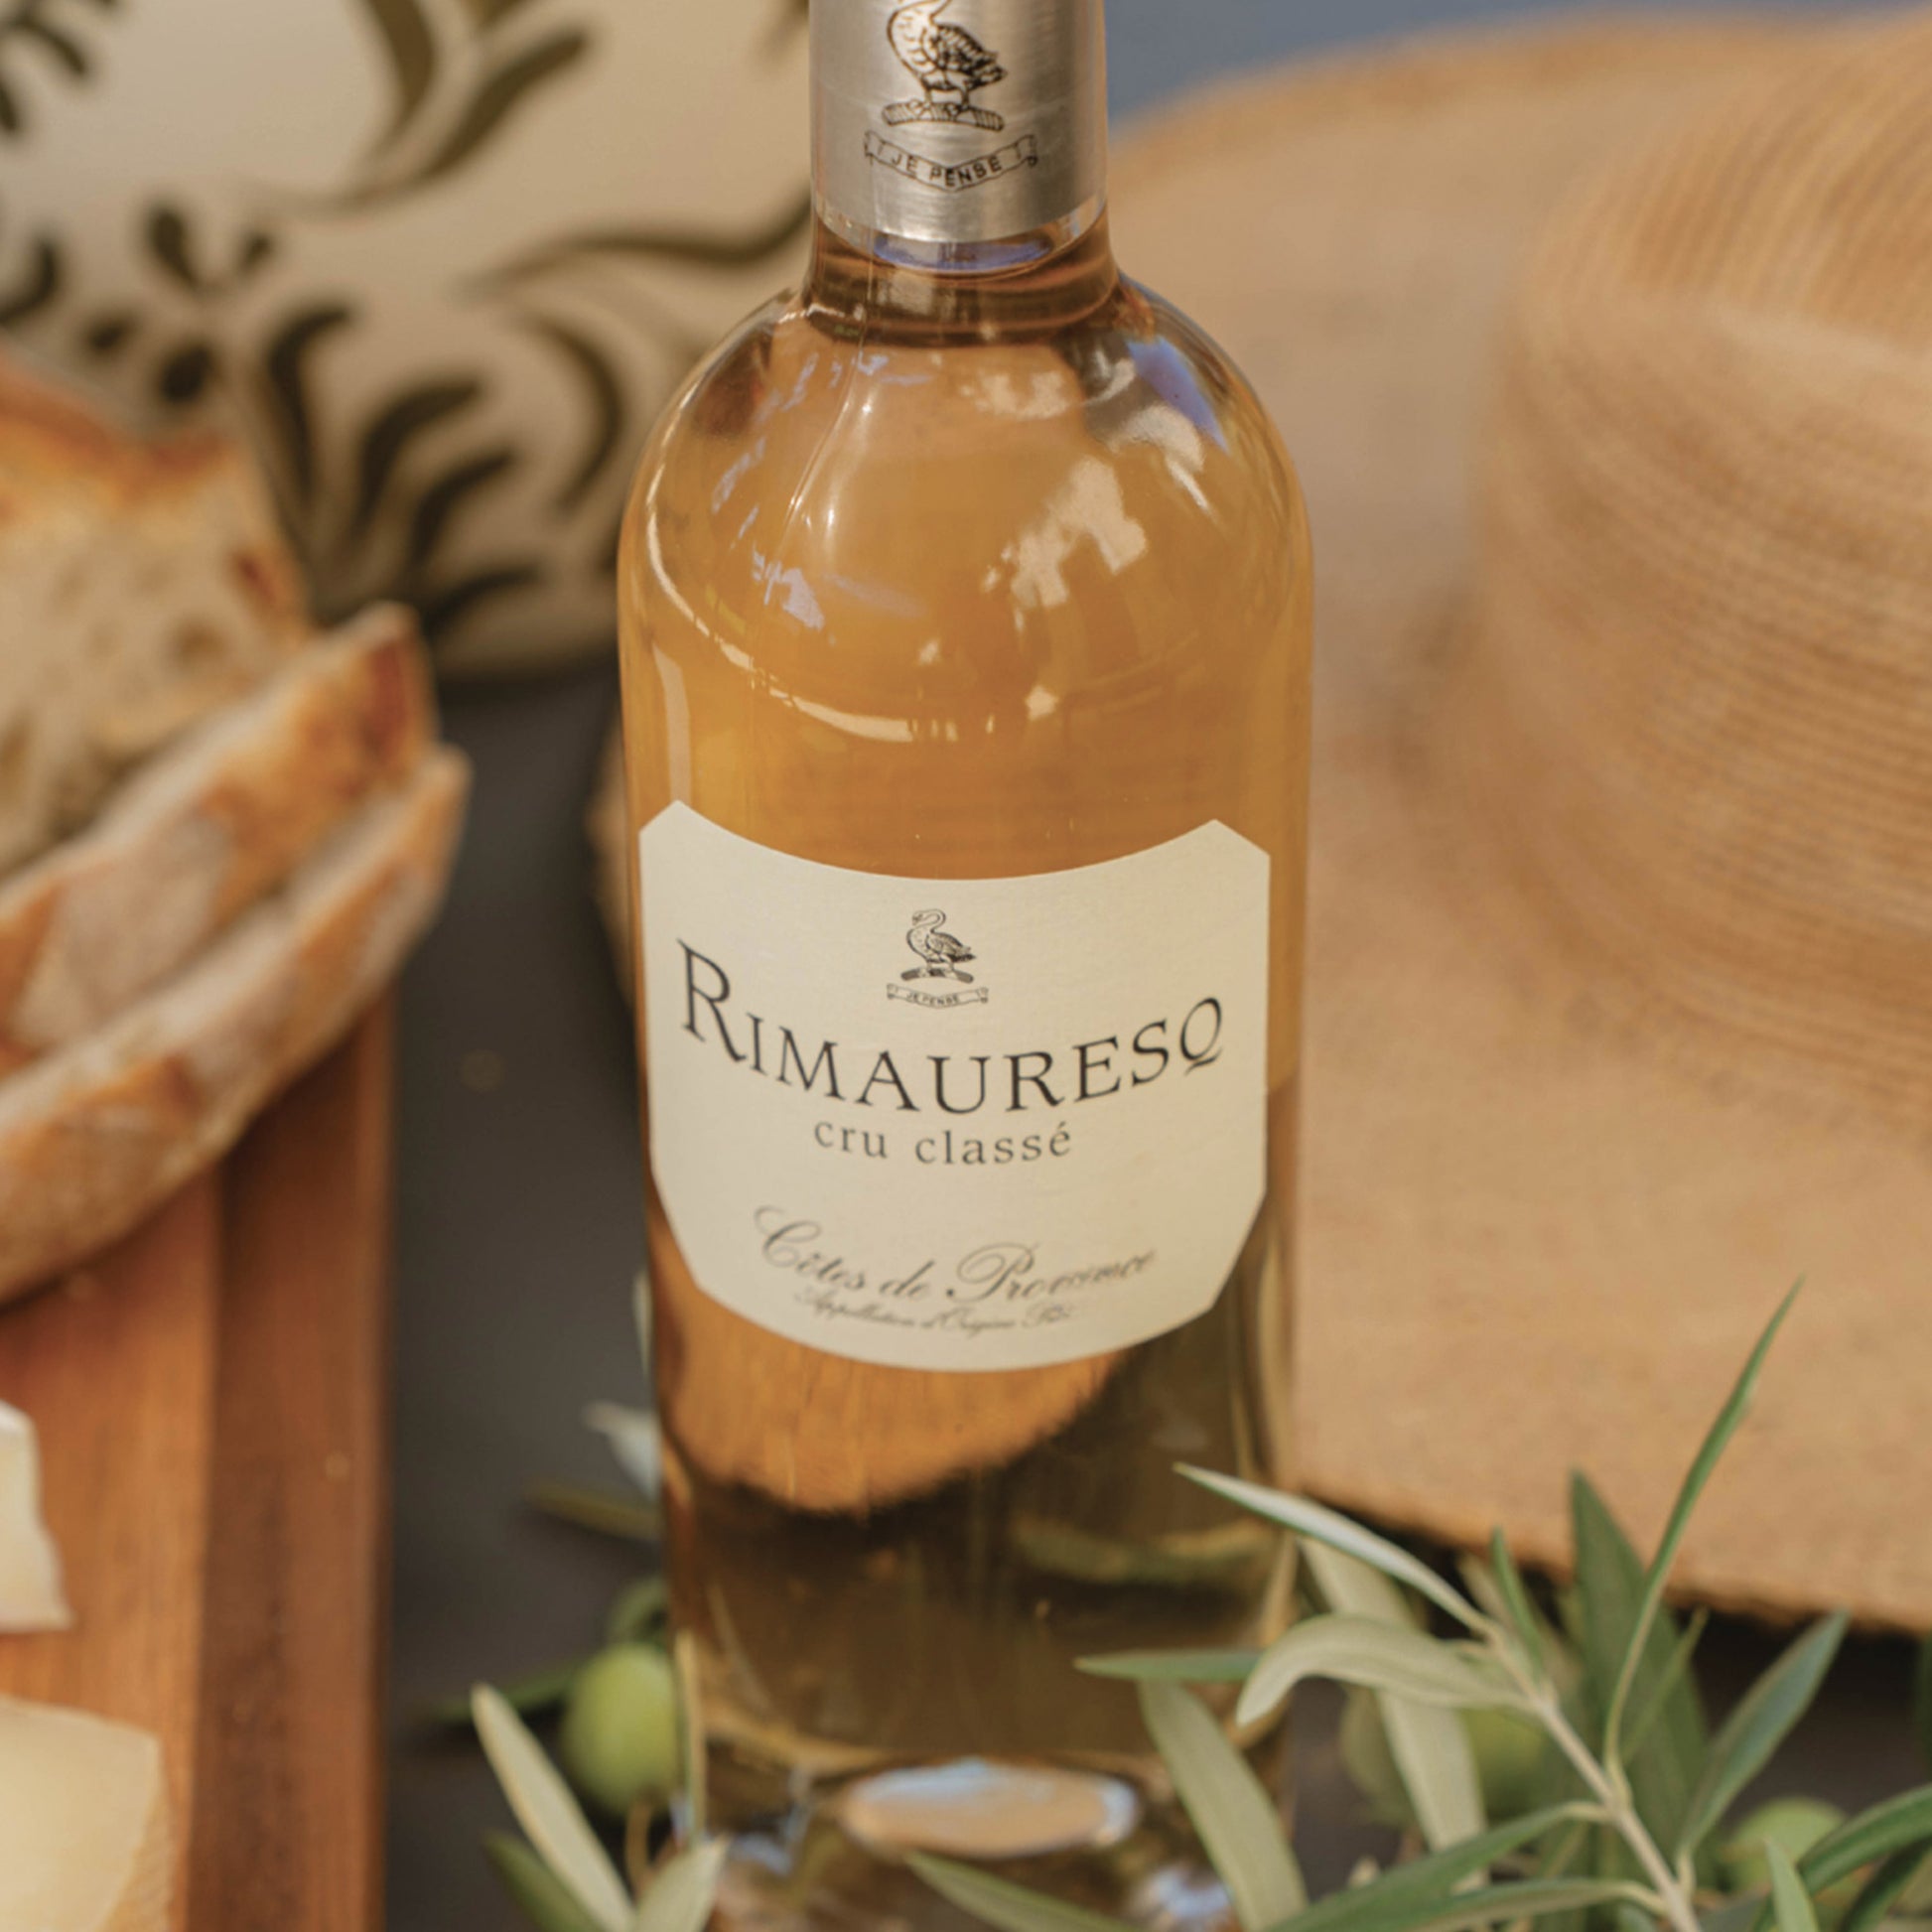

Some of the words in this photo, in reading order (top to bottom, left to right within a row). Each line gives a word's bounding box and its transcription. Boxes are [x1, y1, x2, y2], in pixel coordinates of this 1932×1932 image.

[892, 154, 917, 173] JE
[813, 1121, 889, 1160] cru
[914, 1122, 1072, 1165] classé
[880, 1260, 934, 1301] de
